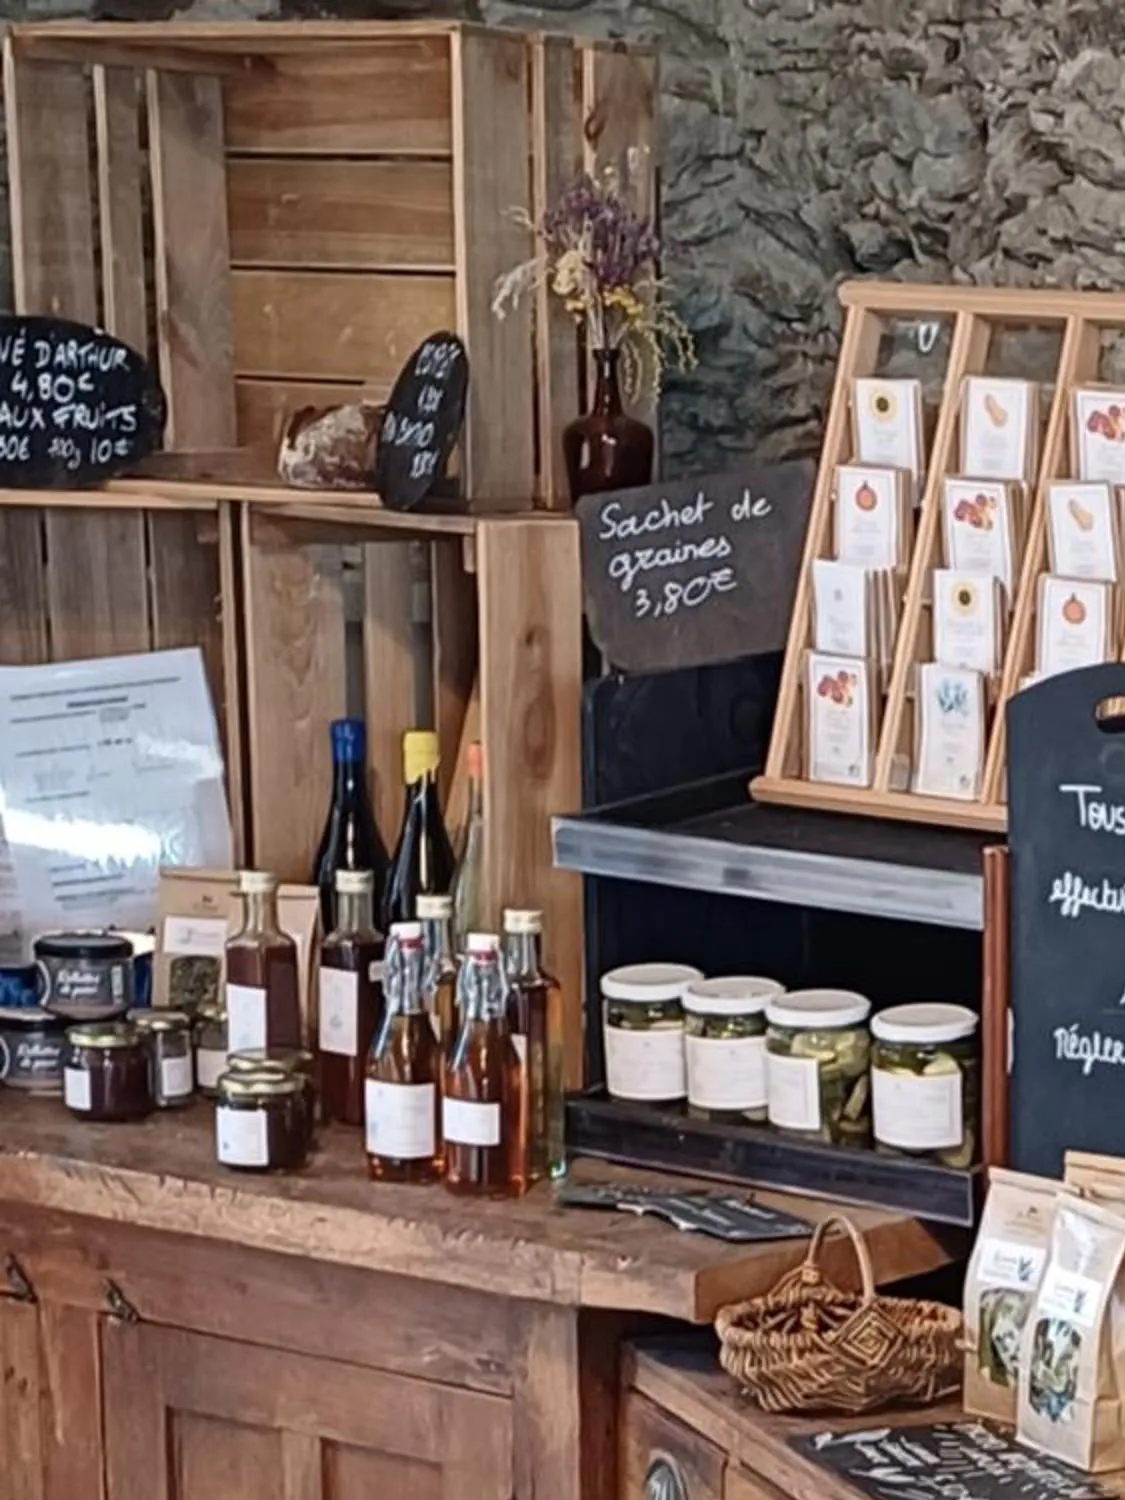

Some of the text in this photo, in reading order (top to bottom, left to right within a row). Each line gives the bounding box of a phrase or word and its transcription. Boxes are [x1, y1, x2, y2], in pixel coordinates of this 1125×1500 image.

[599, 489, 772, 539] Sachet de
[608, 534, 731, 592] graines
[635, 567, 737, 618] 3,80€
